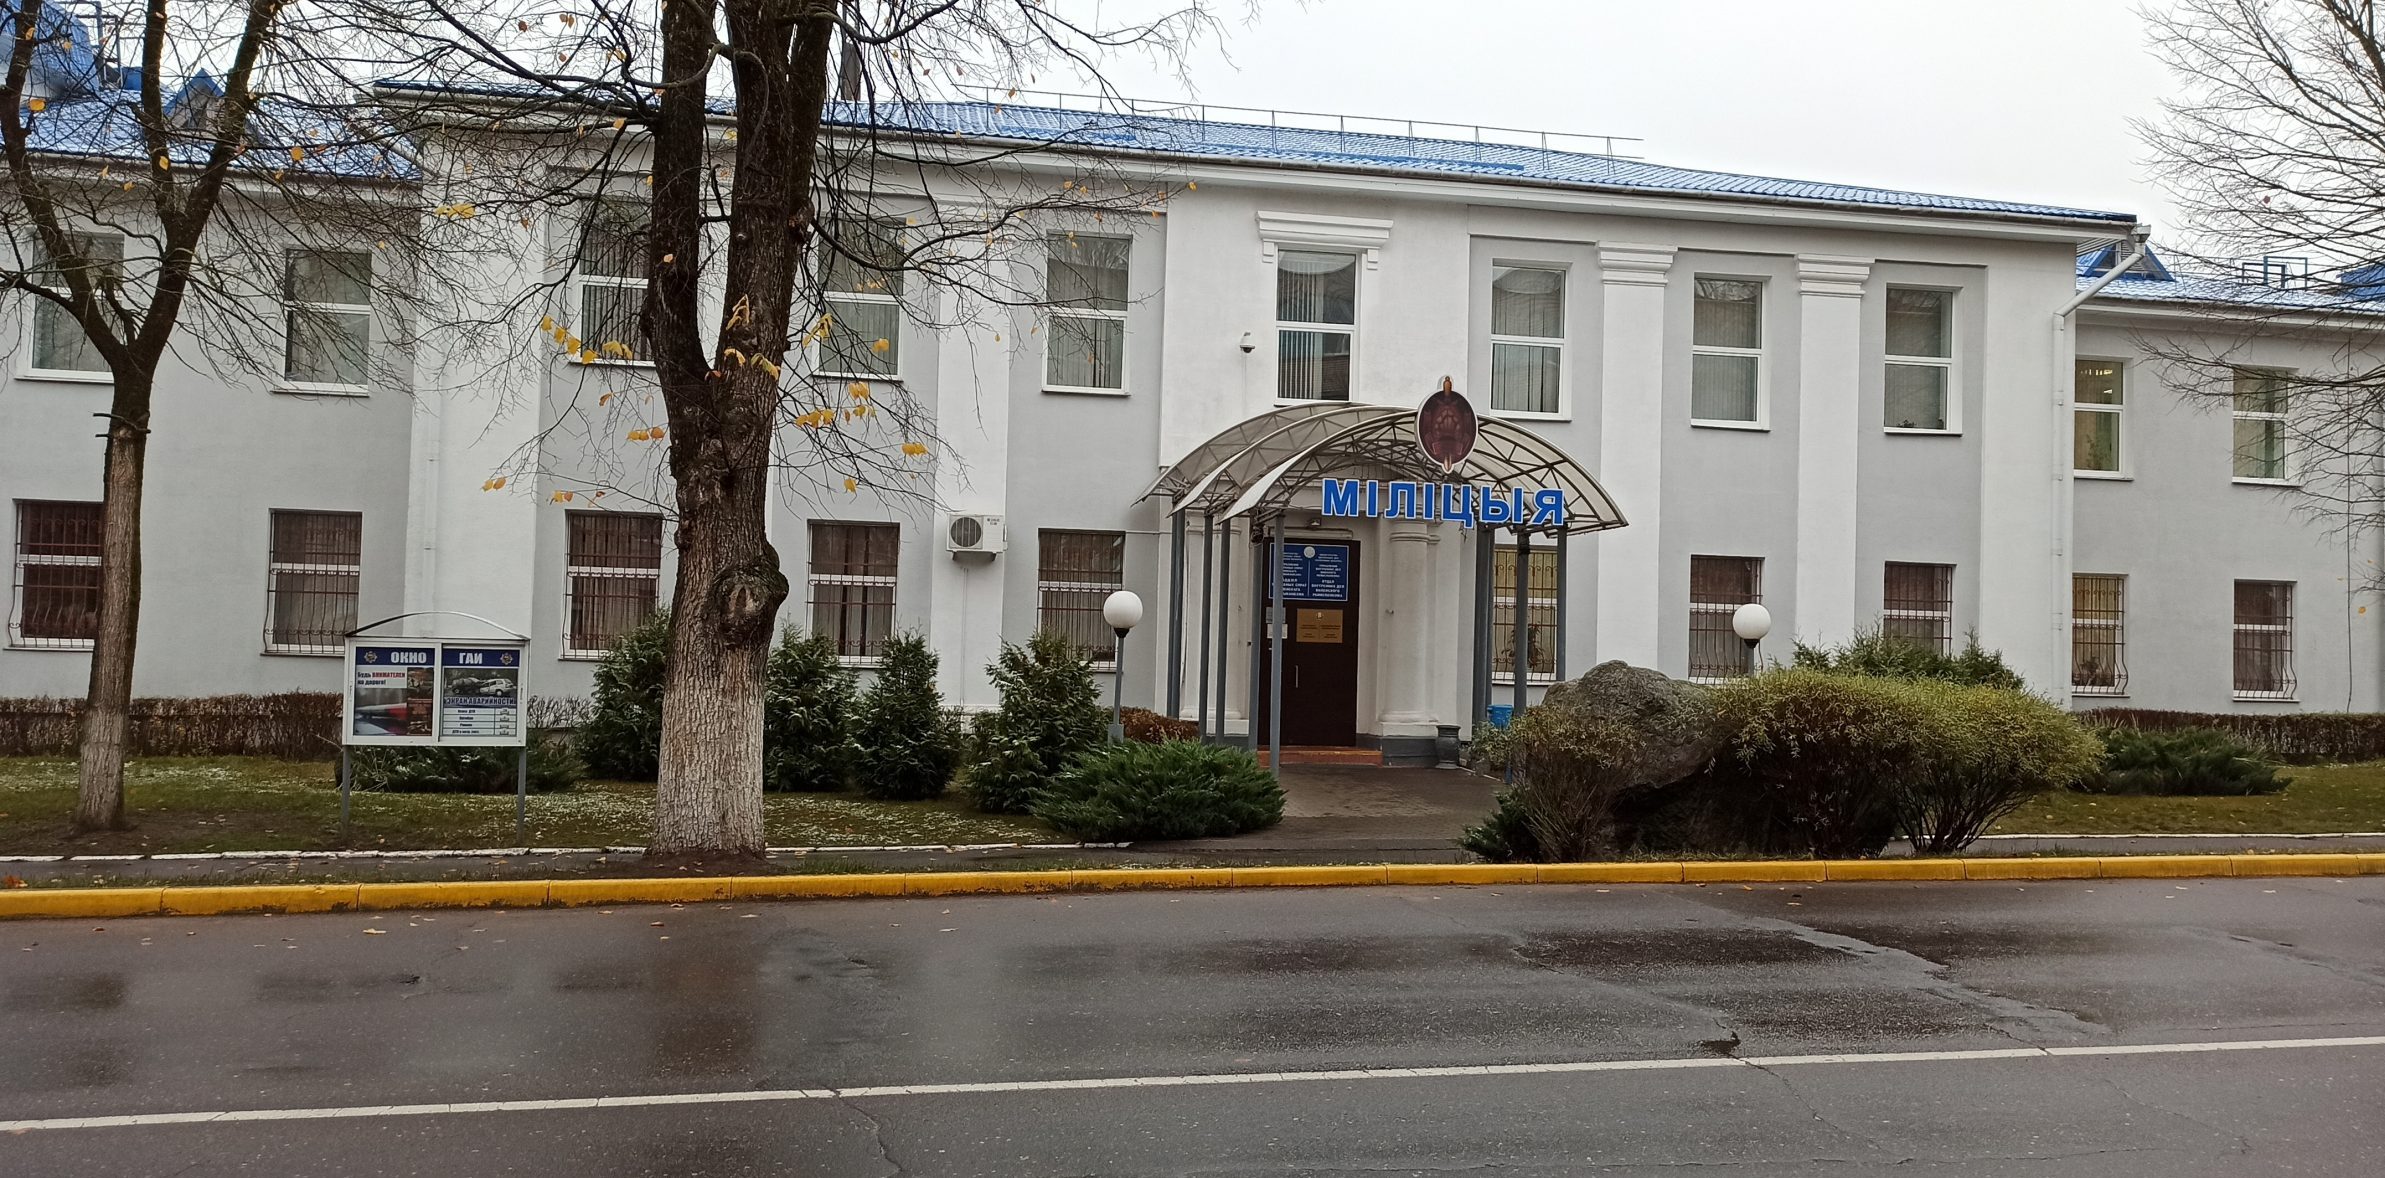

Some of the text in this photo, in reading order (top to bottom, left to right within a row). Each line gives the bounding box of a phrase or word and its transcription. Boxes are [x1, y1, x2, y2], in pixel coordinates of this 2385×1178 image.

[1321, 478, 1564, 529] МІЛІЦЫЯ
[390, 651, 483, 665] ОКНО ГАИ
